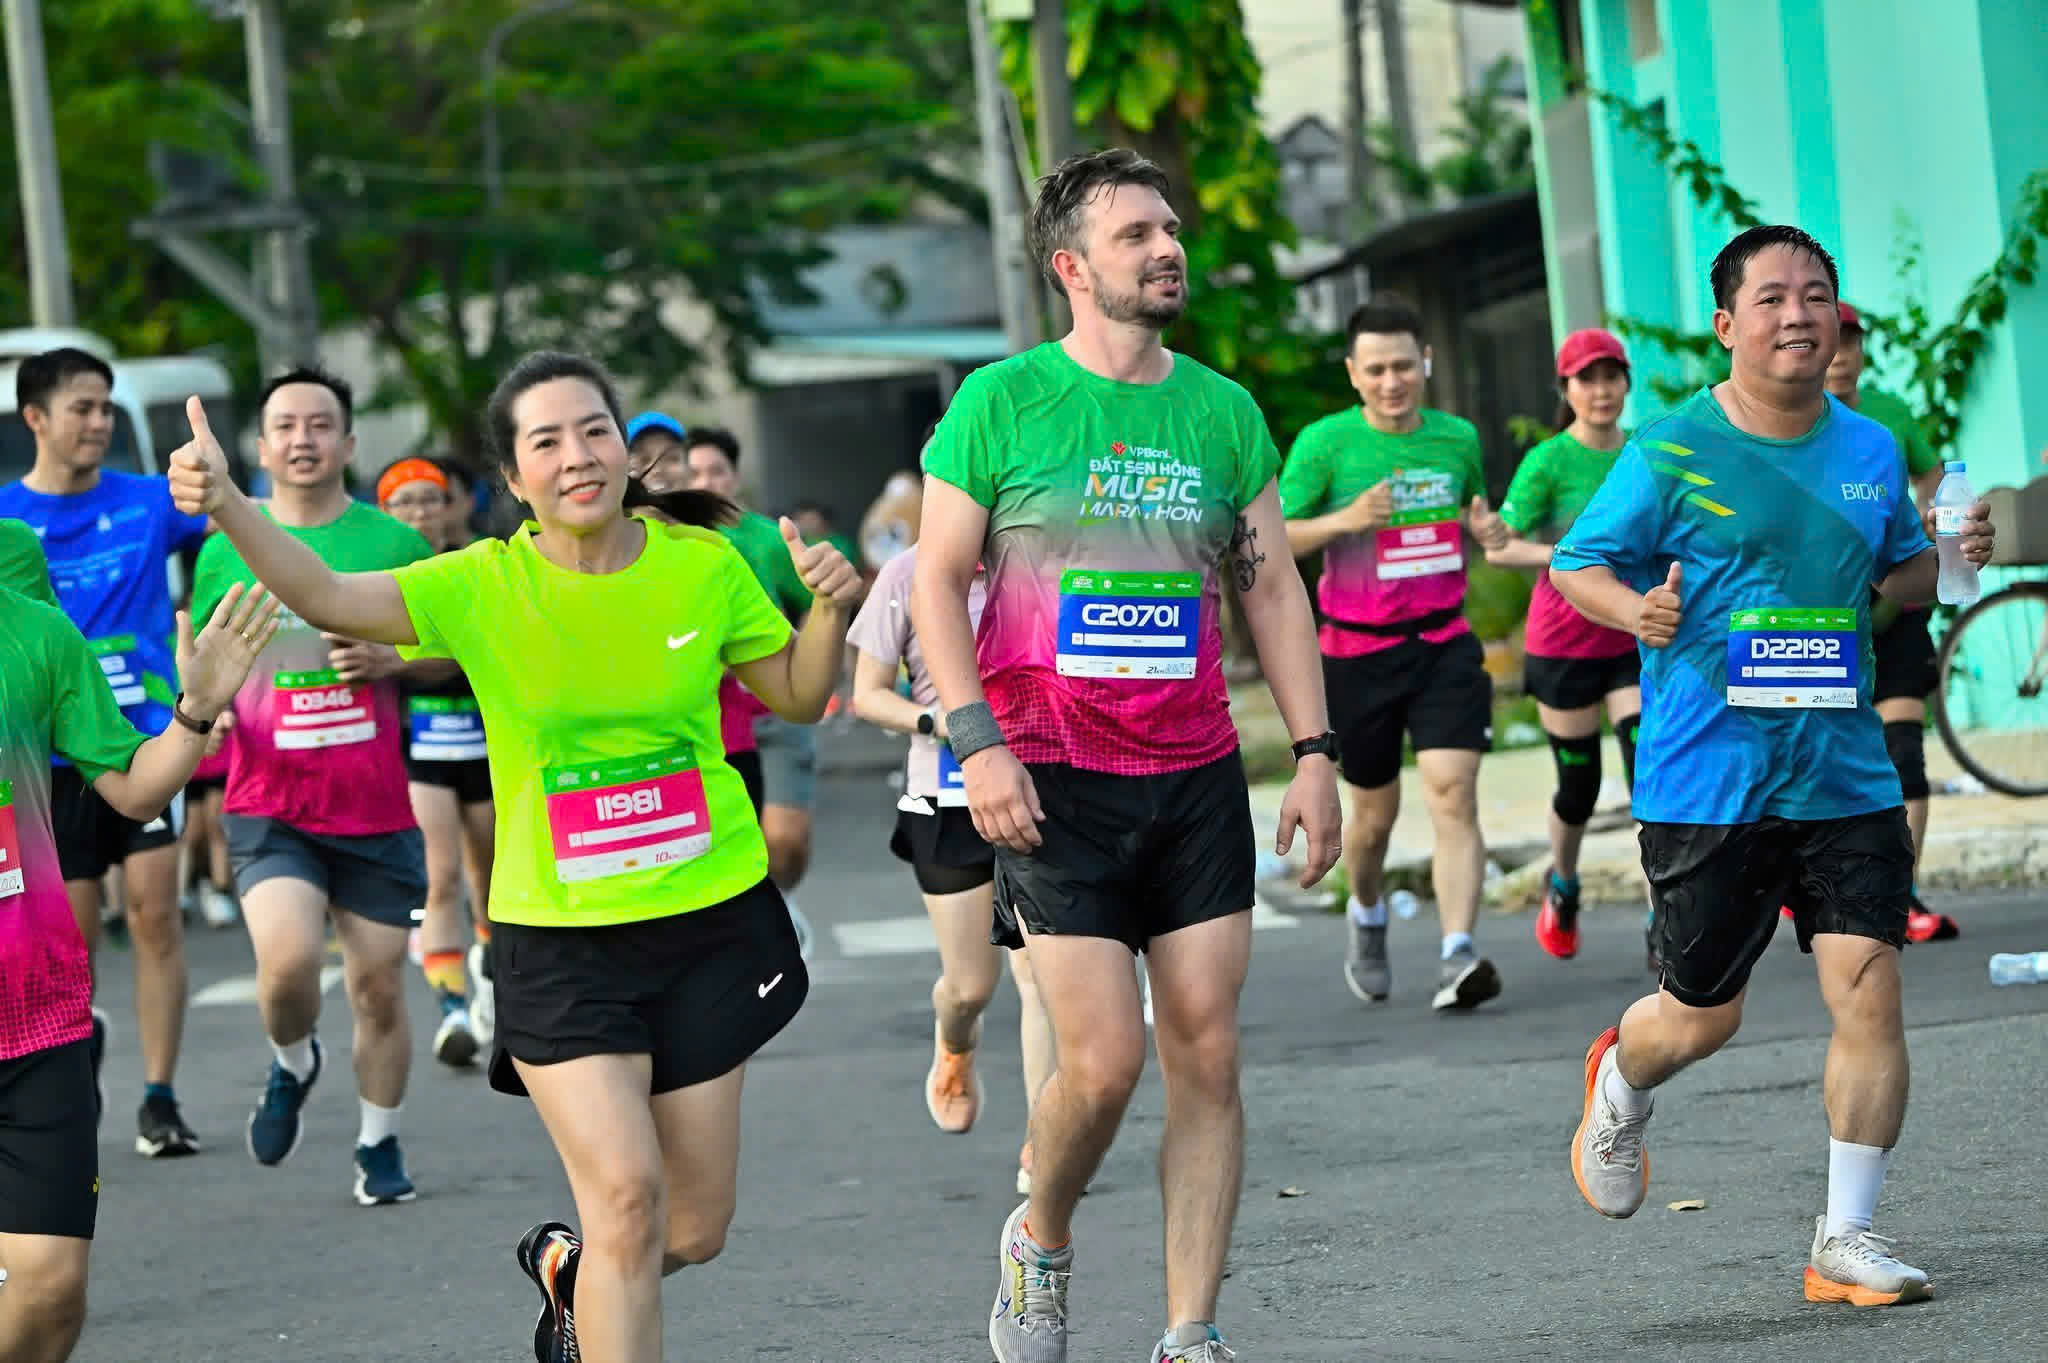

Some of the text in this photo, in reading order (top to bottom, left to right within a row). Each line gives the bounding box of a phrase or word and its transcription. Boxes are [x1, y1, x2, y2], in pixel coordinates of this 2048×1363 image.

[1125, 460, 1156, 475] SEN
[1084, 473, 1202, 504] MUSIC
[1841, 483, 1879, 501] BIDV
[1080, 501, 1203, 523] MARATHON
[1081, 603, 1180, 627] C20701
[1751, 638, 1841, 659] D22192
[594, 786, 663, 822] 11981
